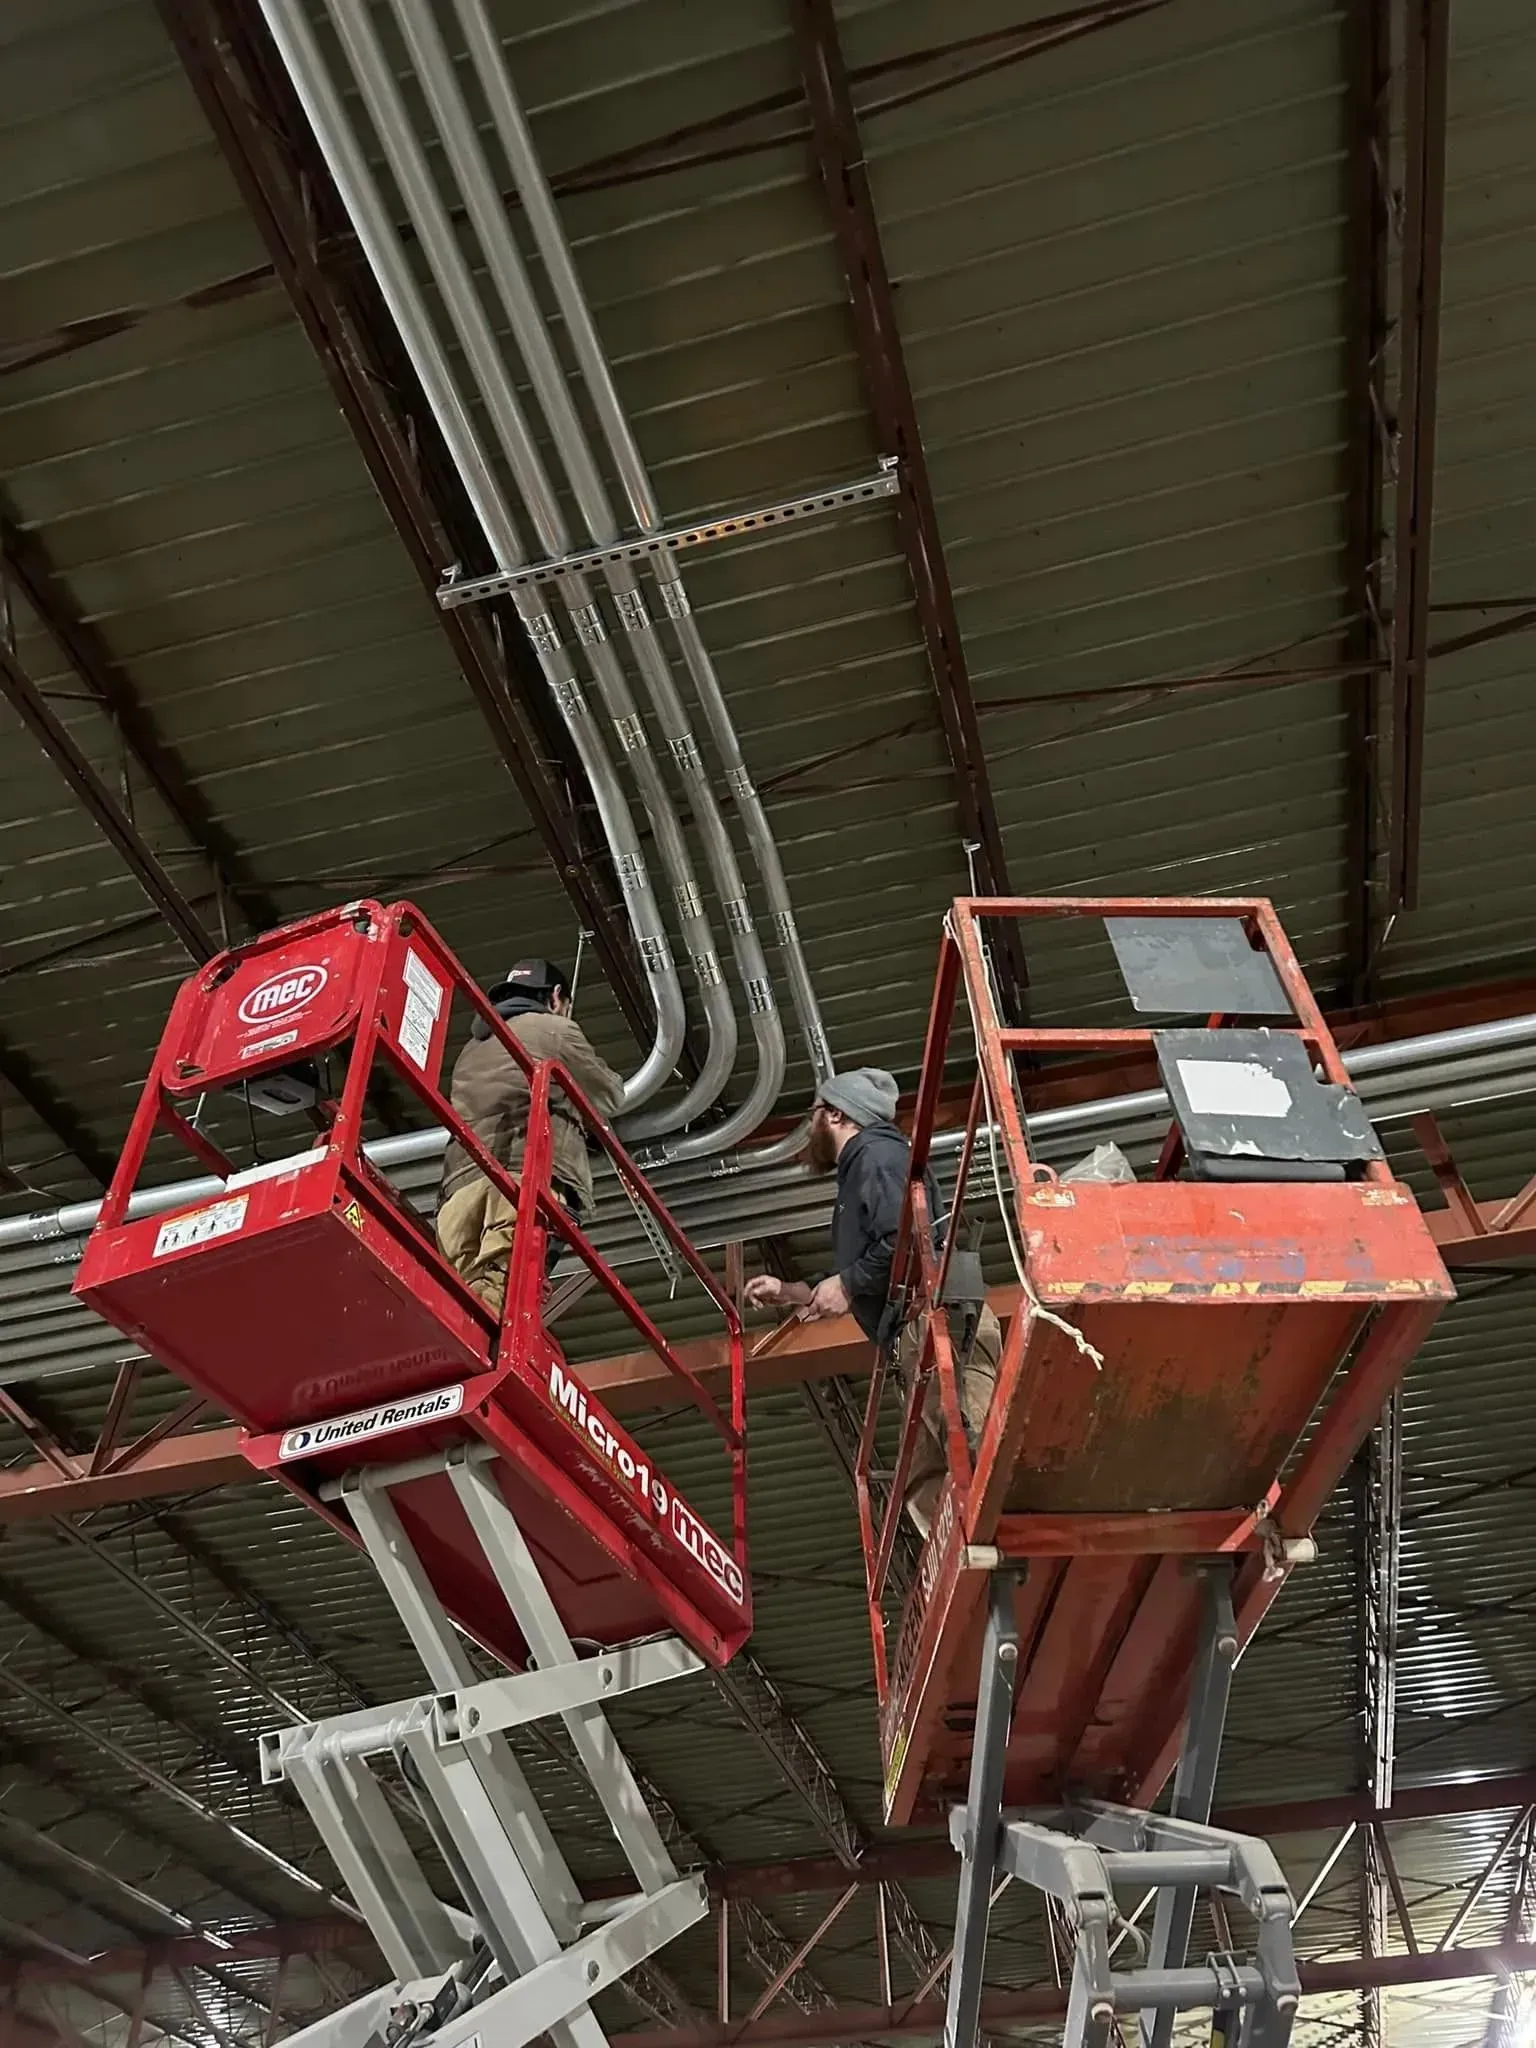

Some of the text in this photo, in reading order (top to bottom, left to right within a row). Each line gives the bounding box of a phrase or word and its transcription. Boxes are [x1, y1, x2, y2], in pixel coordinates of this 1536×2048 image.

[314, 1394, 451, 1444] United Rentals
[549, 1362, 668, 1516] Micro19
[673, 1501, 743, 1601] mec
